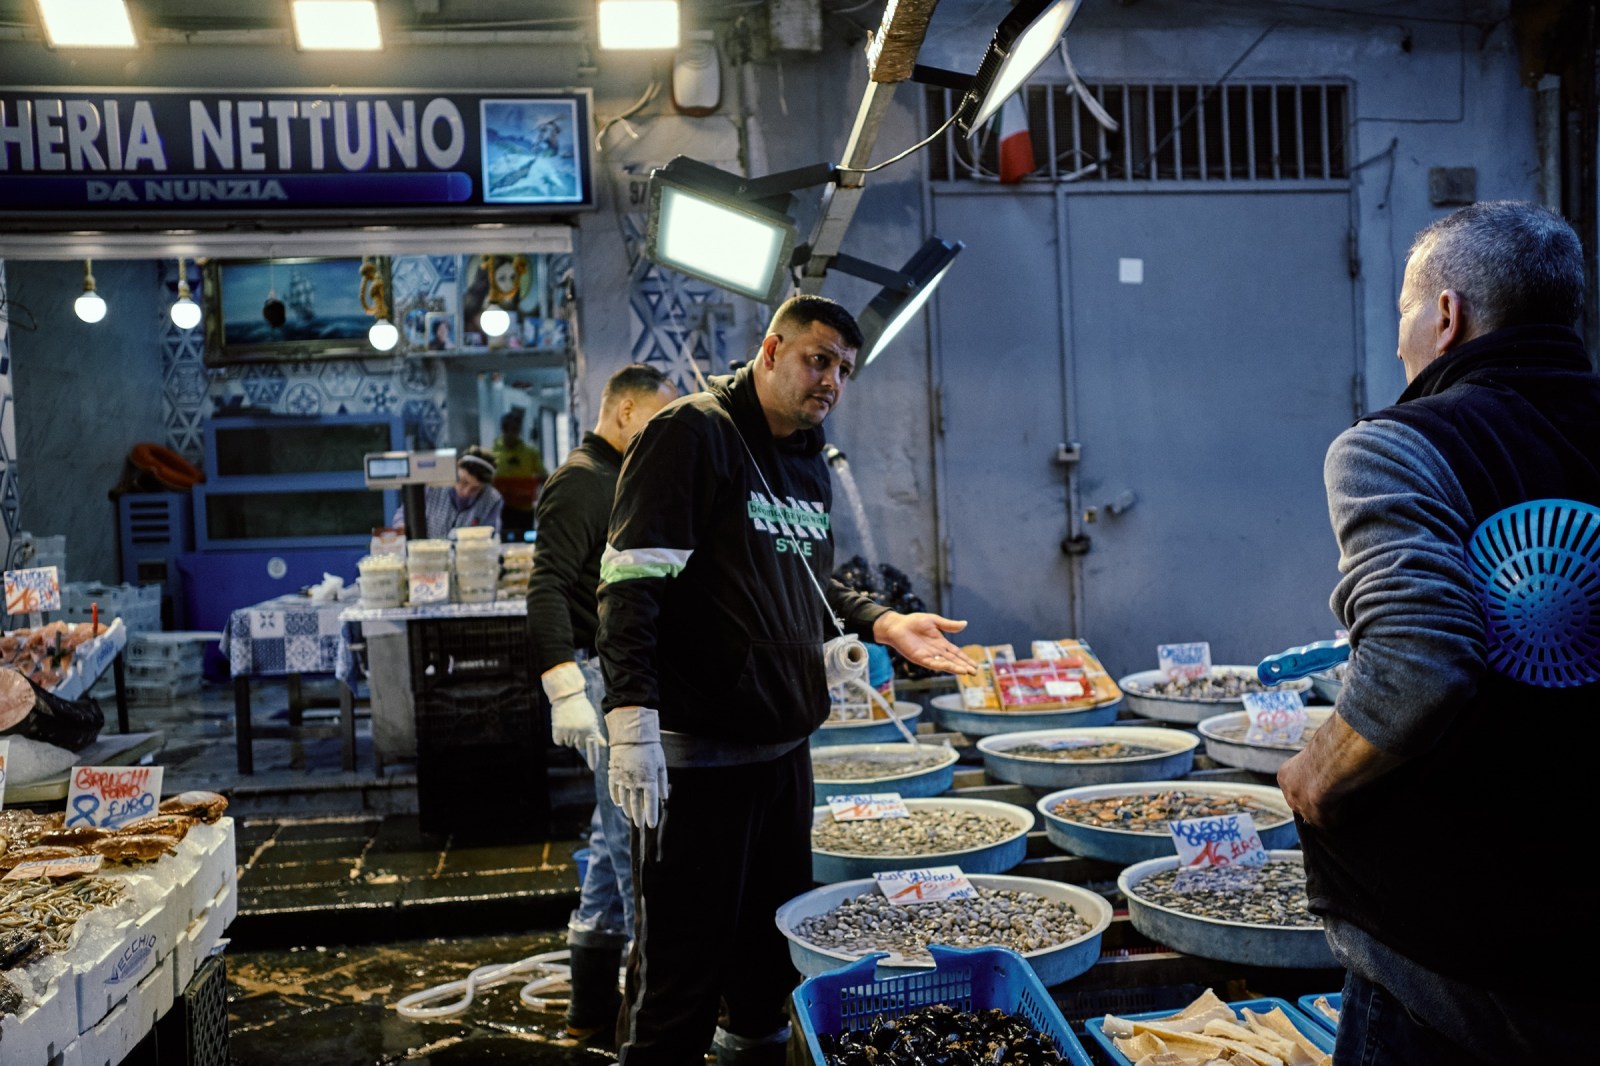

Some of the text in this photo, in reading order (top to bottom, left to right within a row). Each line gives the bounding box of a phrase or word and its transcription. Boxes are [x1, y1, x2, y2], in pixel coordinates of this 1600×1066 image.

[0, 97, 465, 171] HERIA NETTUNO
[86, 179, 288, 201] DA NUNZIA
[776, 538, 813, 556] SYE
[66, 794, 100, 828] 8
[110, 934, 157, 981] VECCHIO
